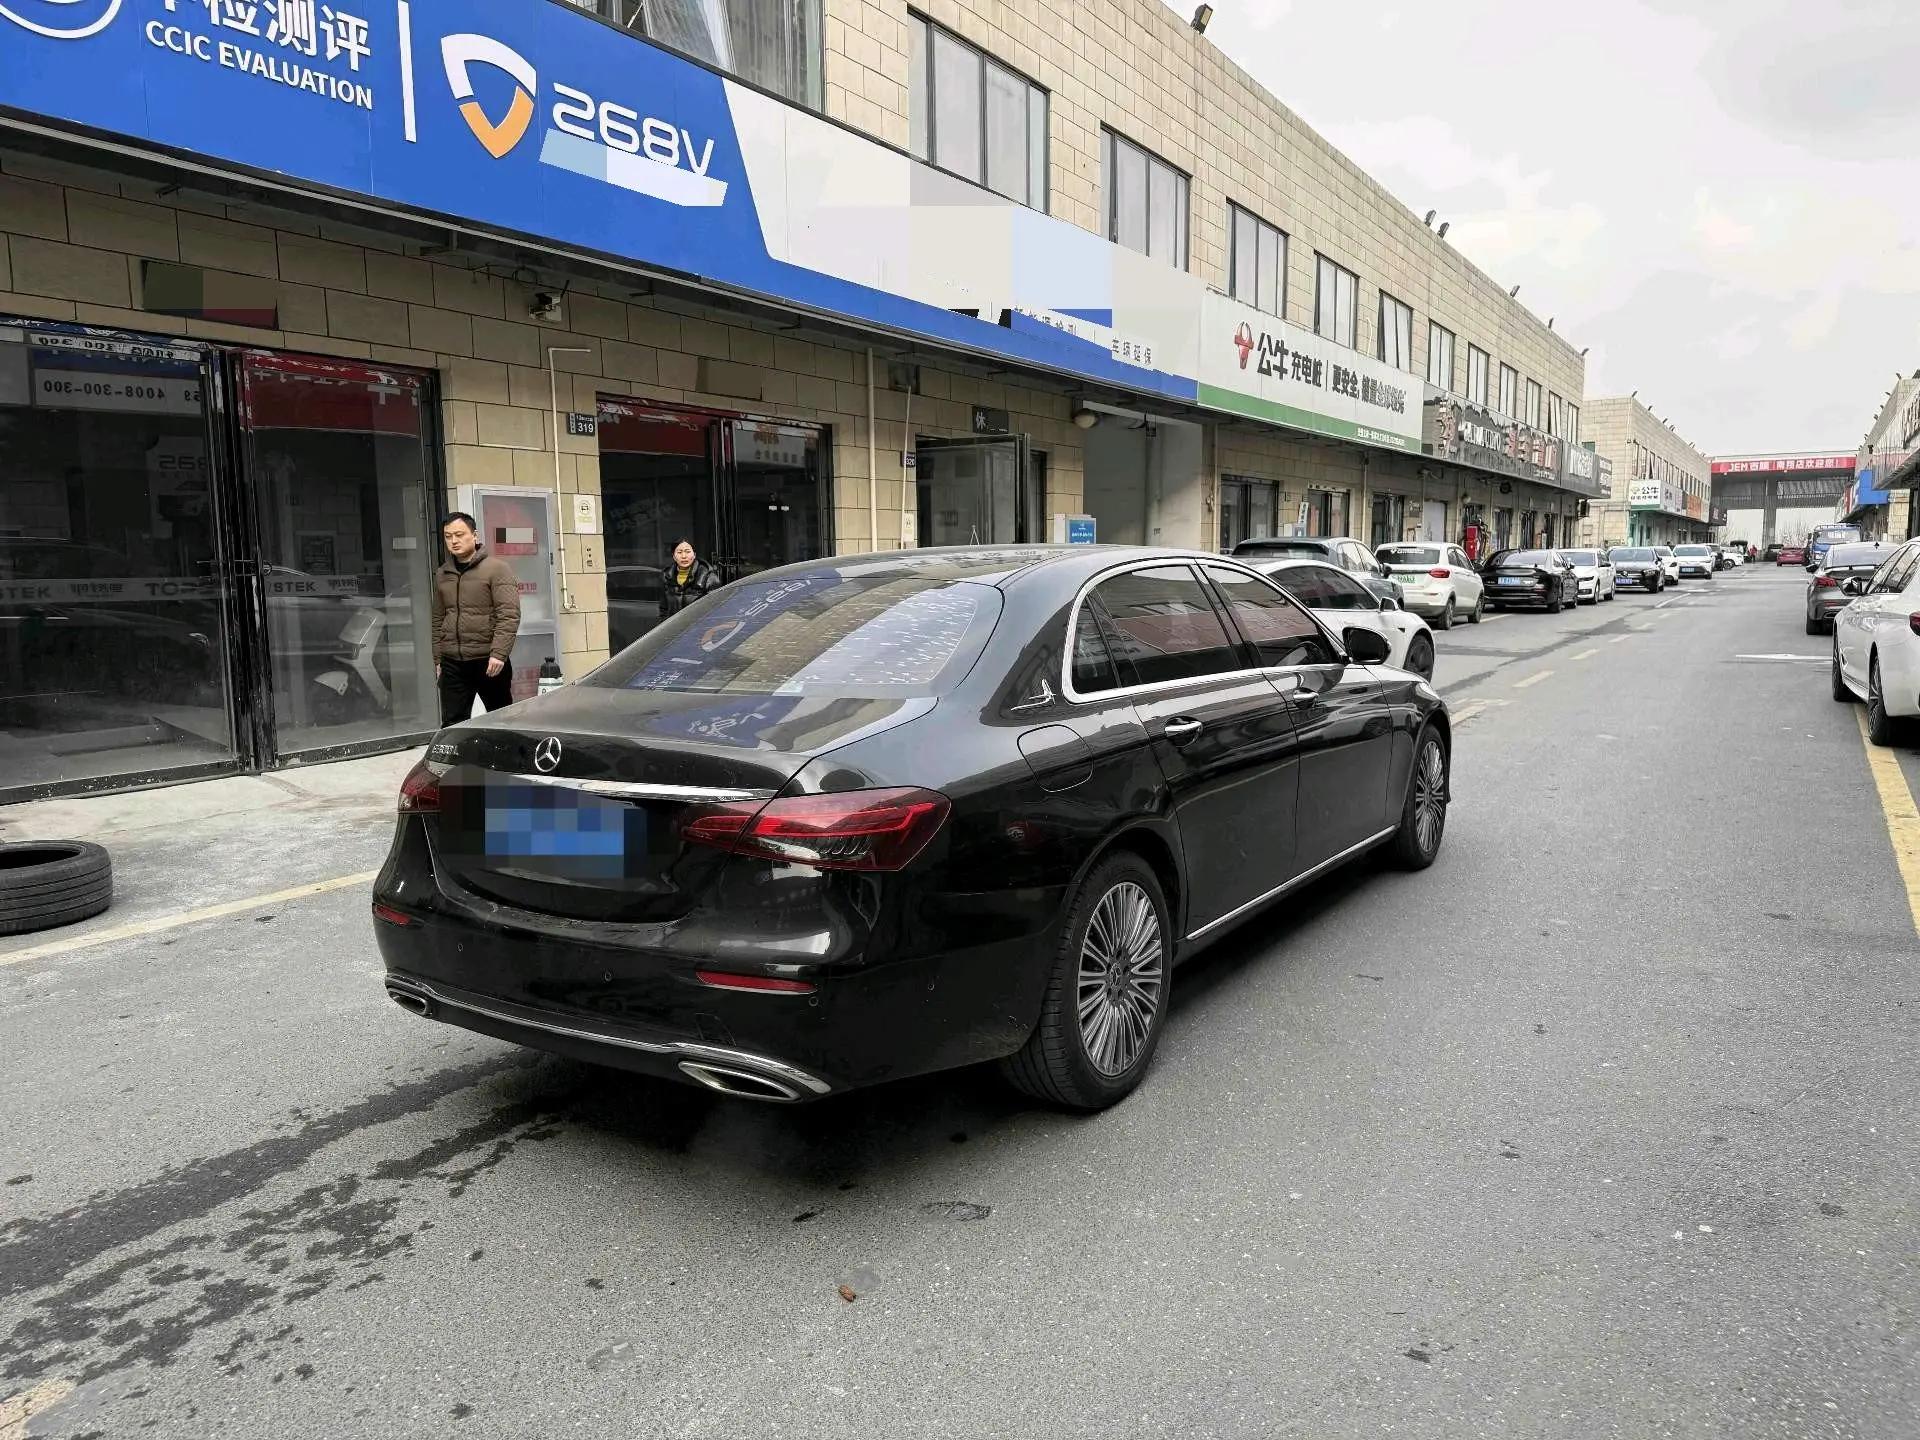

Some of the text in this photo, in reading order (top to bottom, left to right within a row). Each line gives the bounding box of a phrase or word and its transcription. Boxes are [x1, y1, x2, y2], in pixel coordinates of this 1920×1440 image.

[145, 20, 373, 110] CCIC EVALUATION
[164, 0, 371, 71] 检测评
[552, 82, 715, 176] 268V
[1257, 332, 1289, 381] 公牛
[577, 422, 594, 433] 319
[1728, 462, 1748, 473] JEM
